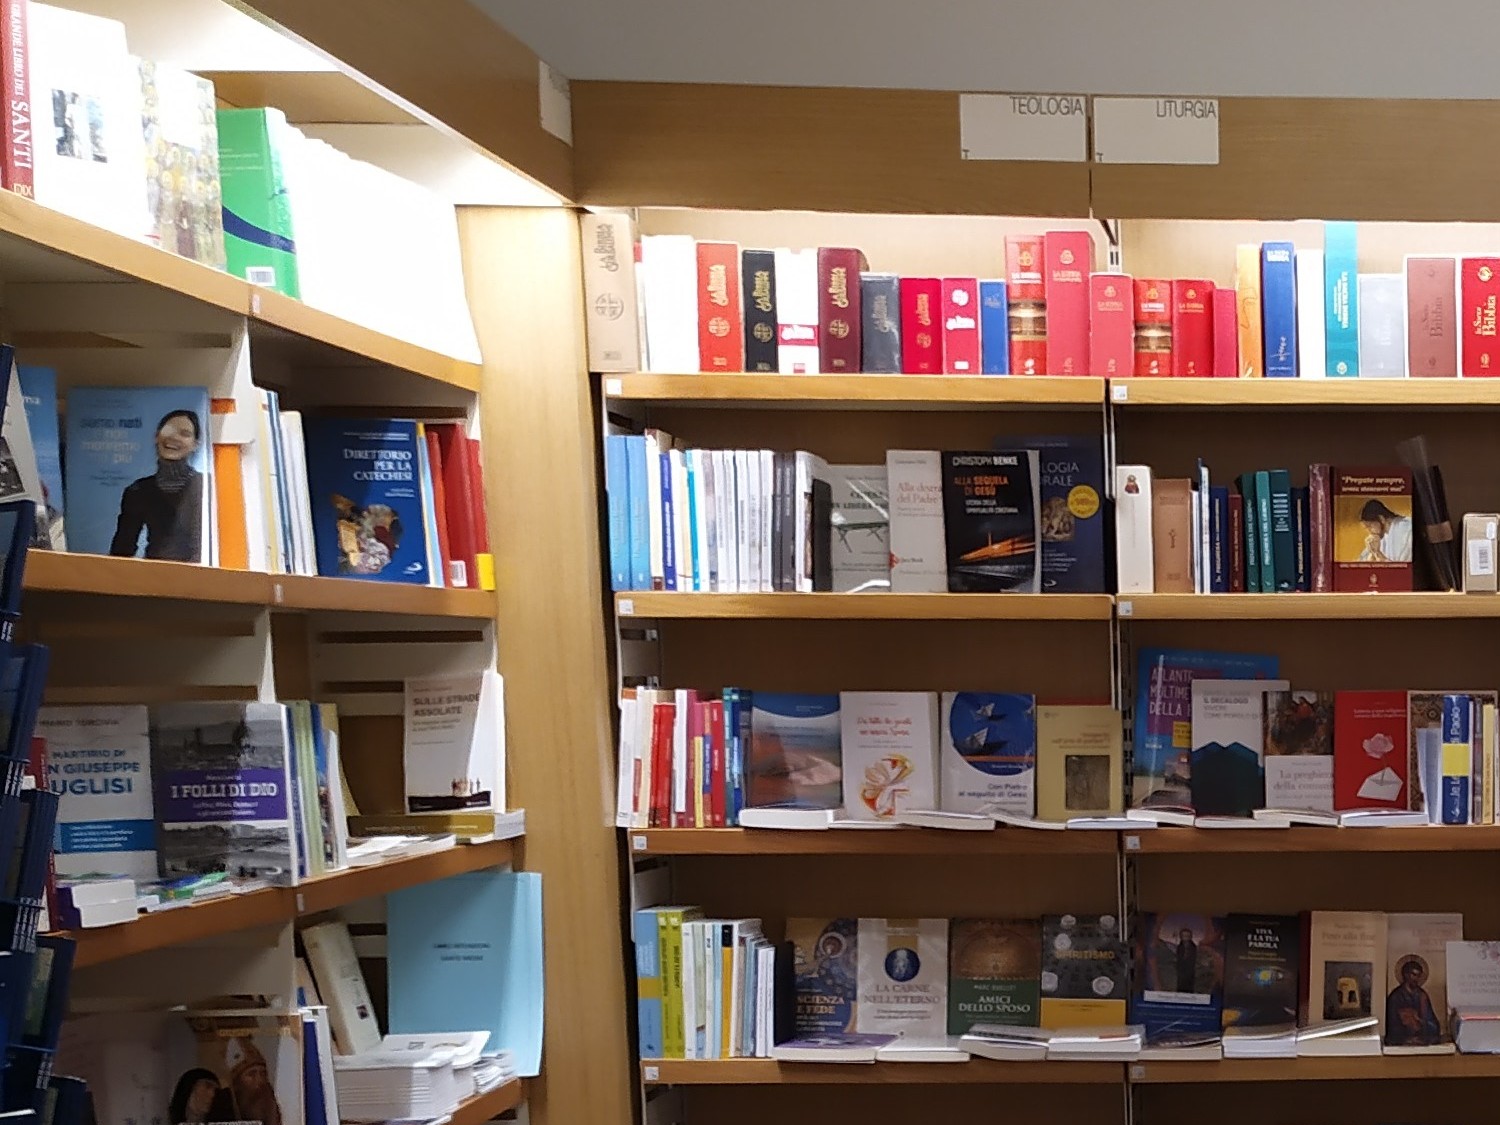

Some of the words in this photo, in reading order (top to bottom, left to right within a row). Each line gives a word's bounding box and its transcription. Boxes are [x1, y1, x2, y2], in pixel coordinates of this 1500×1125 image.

[1009, 95, 1085, 116] TEOLOGIA
[11, 100, 32, 170] SANTI
[64, 761, 140, 774] GIUSEPPE
[51, 777, 134, 796] UGLISI
[181, 783, 225, 799] FOLLI
[228, 782, 247, 798] DI
[249, 782, 278, 797] DIO
